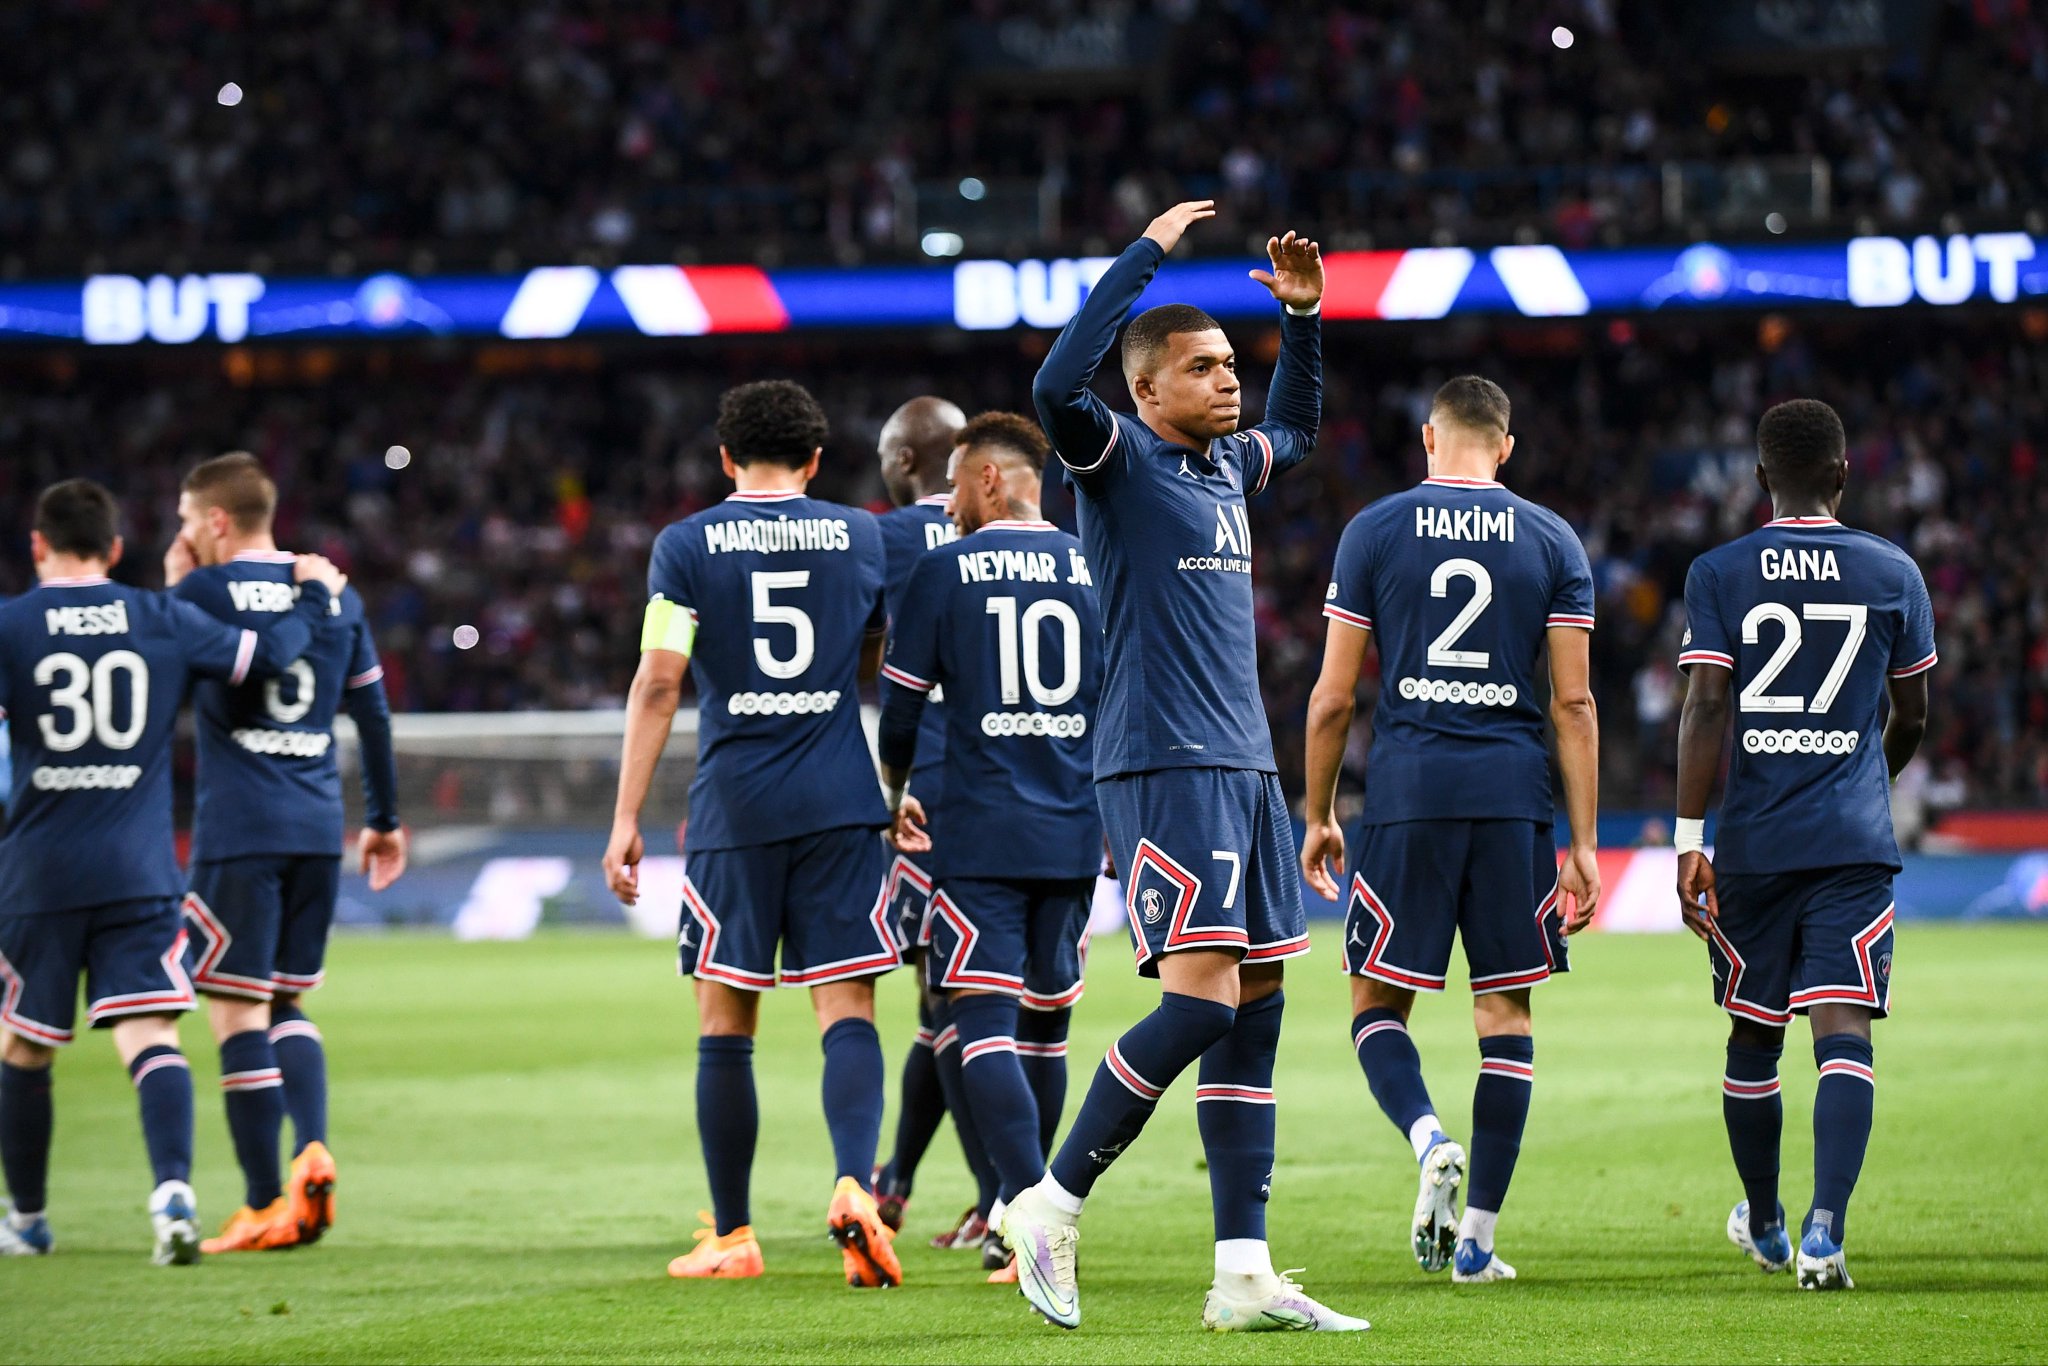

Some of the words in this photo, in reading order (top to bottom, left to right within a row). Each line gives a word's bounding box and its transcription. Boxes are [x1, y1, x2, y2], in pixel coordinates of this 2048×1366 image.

[1847, 232, 2035, 307] BUT
[82, 273, 265, 344] BUT
[957, 549, 1057, 583] NEYMAR
[1177, 557, 1222, 571] ACCOR
[1223, 558, 1241, 573] LIVE
[1761, 547, 1841, 581] GANA
[752, 571, 815, 679] 5
[1427, 559, 1493, 669] 2
[986, 597, 1081, 707] 10
[1740, 603, 1868, 713] 27
[34, 650, 149, 752] 30
[1398, 677, 1517, 707] ooredoo
[1743, 729, 1860, 755] ooredoo
[1212, 851, 1241, 909] 7
